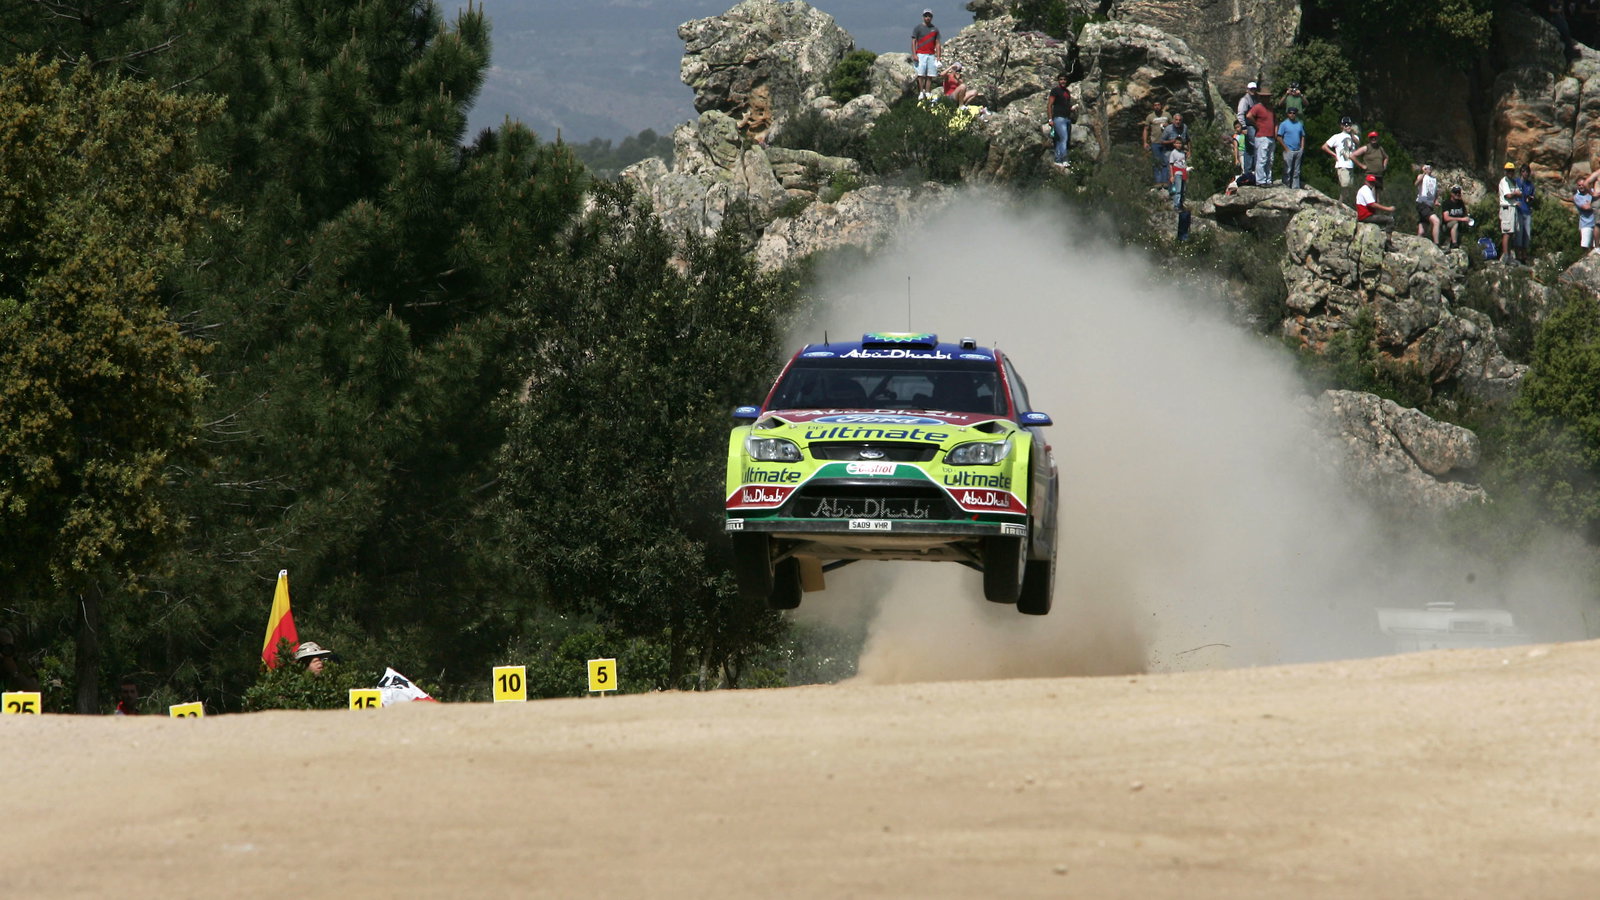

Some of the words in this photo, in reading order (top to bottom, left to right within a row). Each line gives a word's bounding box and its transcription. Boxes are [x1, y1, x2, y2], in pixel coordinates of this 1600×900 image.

[836, 414, 919, 424] Ford
[805, 427, 949, 442] ultimate
[597, 667, 607, 683] 5
[498, 674, 521, 693] 10
